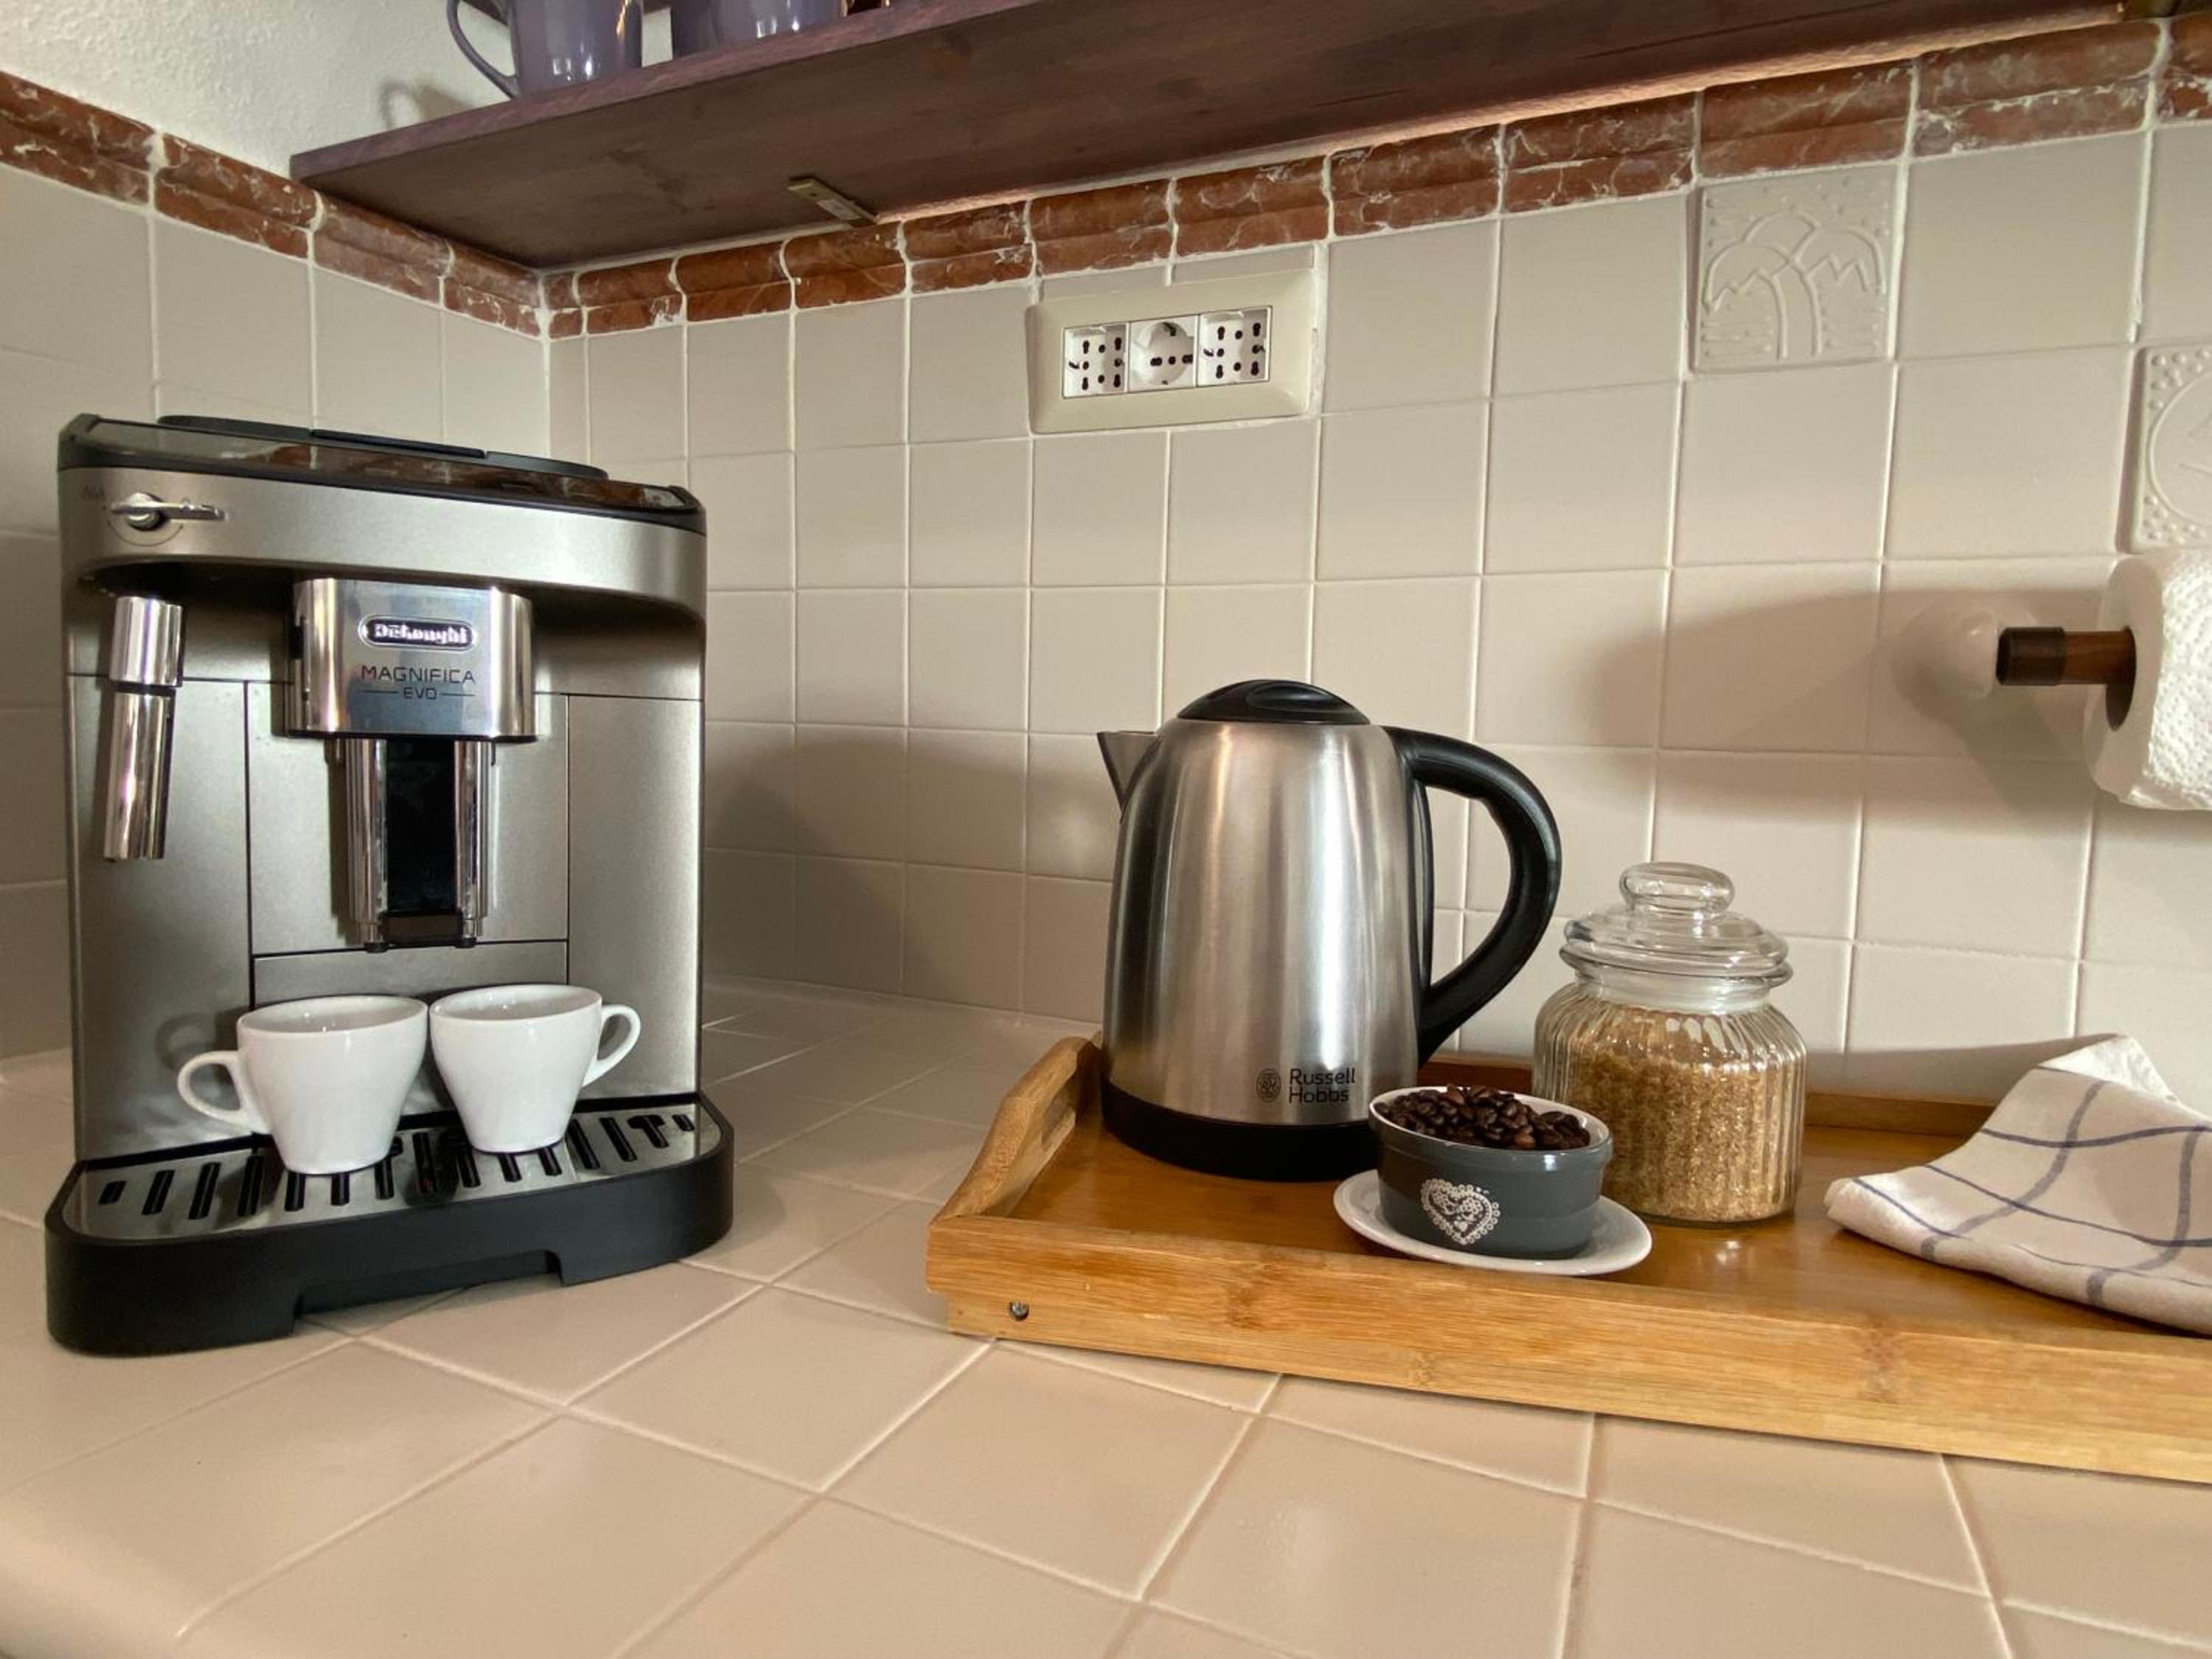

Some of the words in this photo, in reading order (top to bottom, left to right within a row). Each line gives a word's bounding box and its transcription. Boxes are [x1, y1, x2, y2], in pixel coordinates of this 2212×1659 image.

[361, 665, 476, 685] MAGNIFICA
[403, 686, 437, 700] EVO
[1290, 1068, 1356, 1085] Russell
[1288, 1086, 1349, 1104] Hobbs
